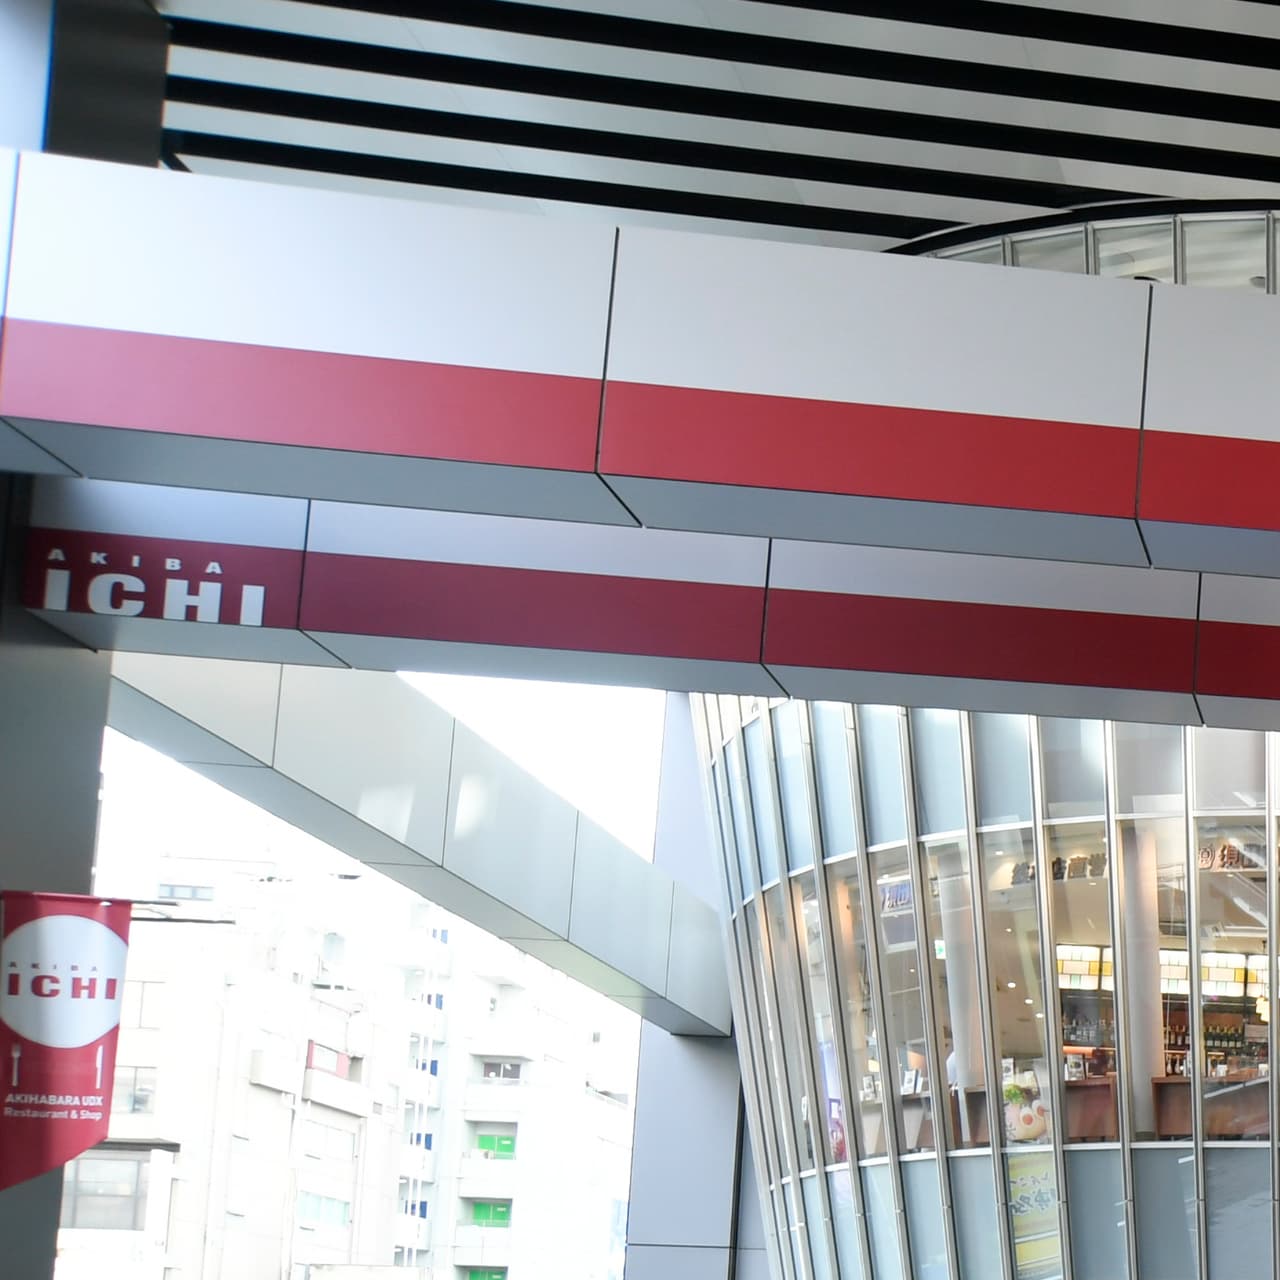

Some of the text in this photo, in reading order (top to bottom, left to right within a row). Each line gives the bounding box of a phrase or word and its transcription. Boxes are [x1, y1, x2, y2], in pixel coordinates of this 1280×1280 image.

[48, 549, 223, 574] AKIBA
[44, 568, 265, 627] ICHI
[8, 973, 118, 1000] ICHI
[6, 1093, 80, 1106] AKIHABARA
[4, 1106, 69, 1119] Restaurant
